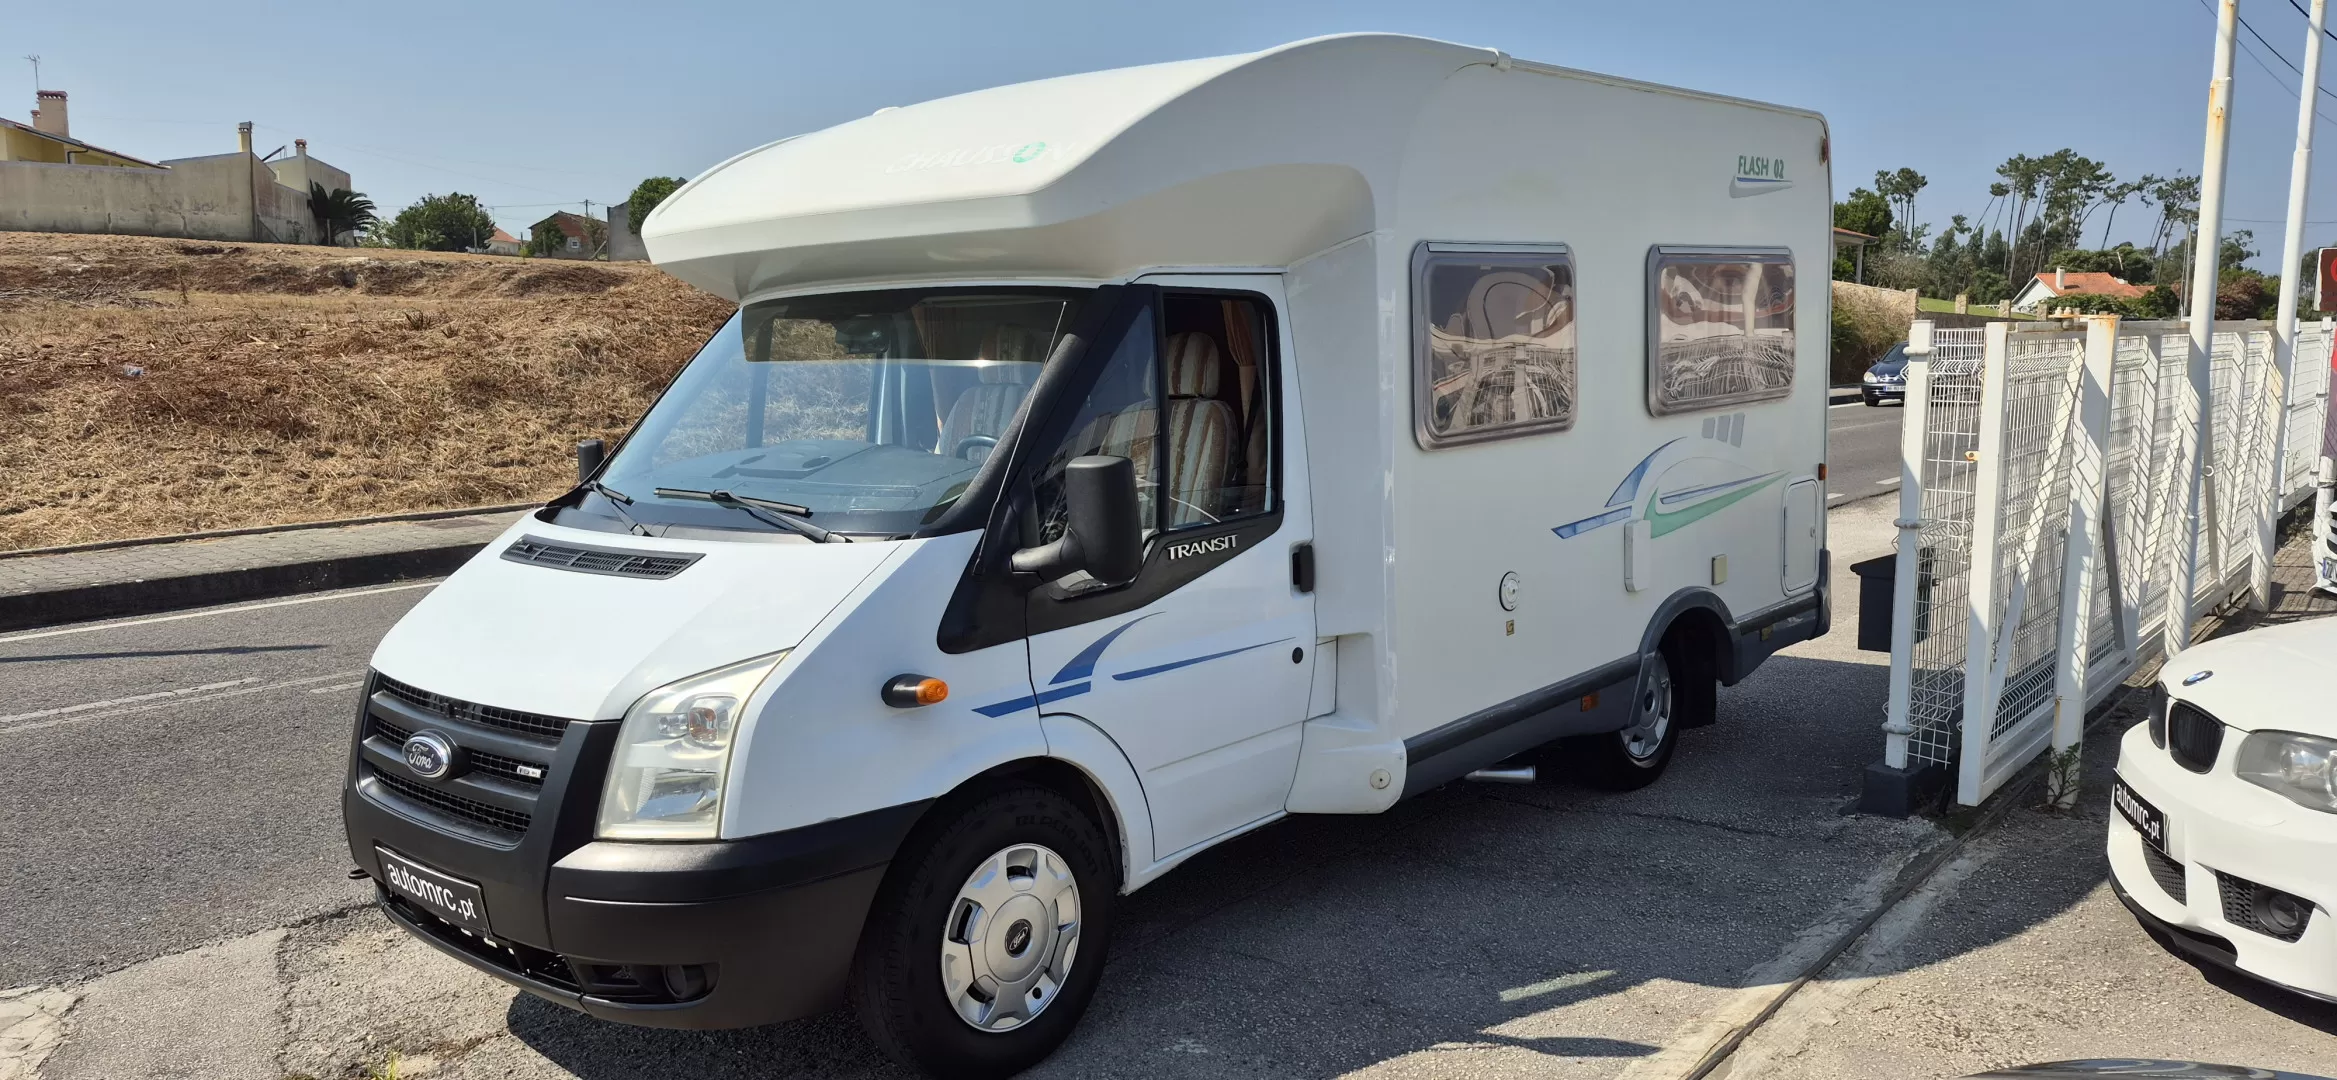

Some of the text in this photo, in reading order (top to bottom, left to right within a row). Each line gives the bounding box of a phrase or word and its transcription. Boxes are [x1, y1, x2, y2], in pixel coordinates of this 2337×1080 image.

[1738, 155, 1785, 179] FLASH 02
[1167, 534, 1238, 561] TRANSIT
[408, 743, 434, 769] Ford
[2116, 783, 2160, 840] automrc.pt
[387, 863, 477, 921] automrc.pt
